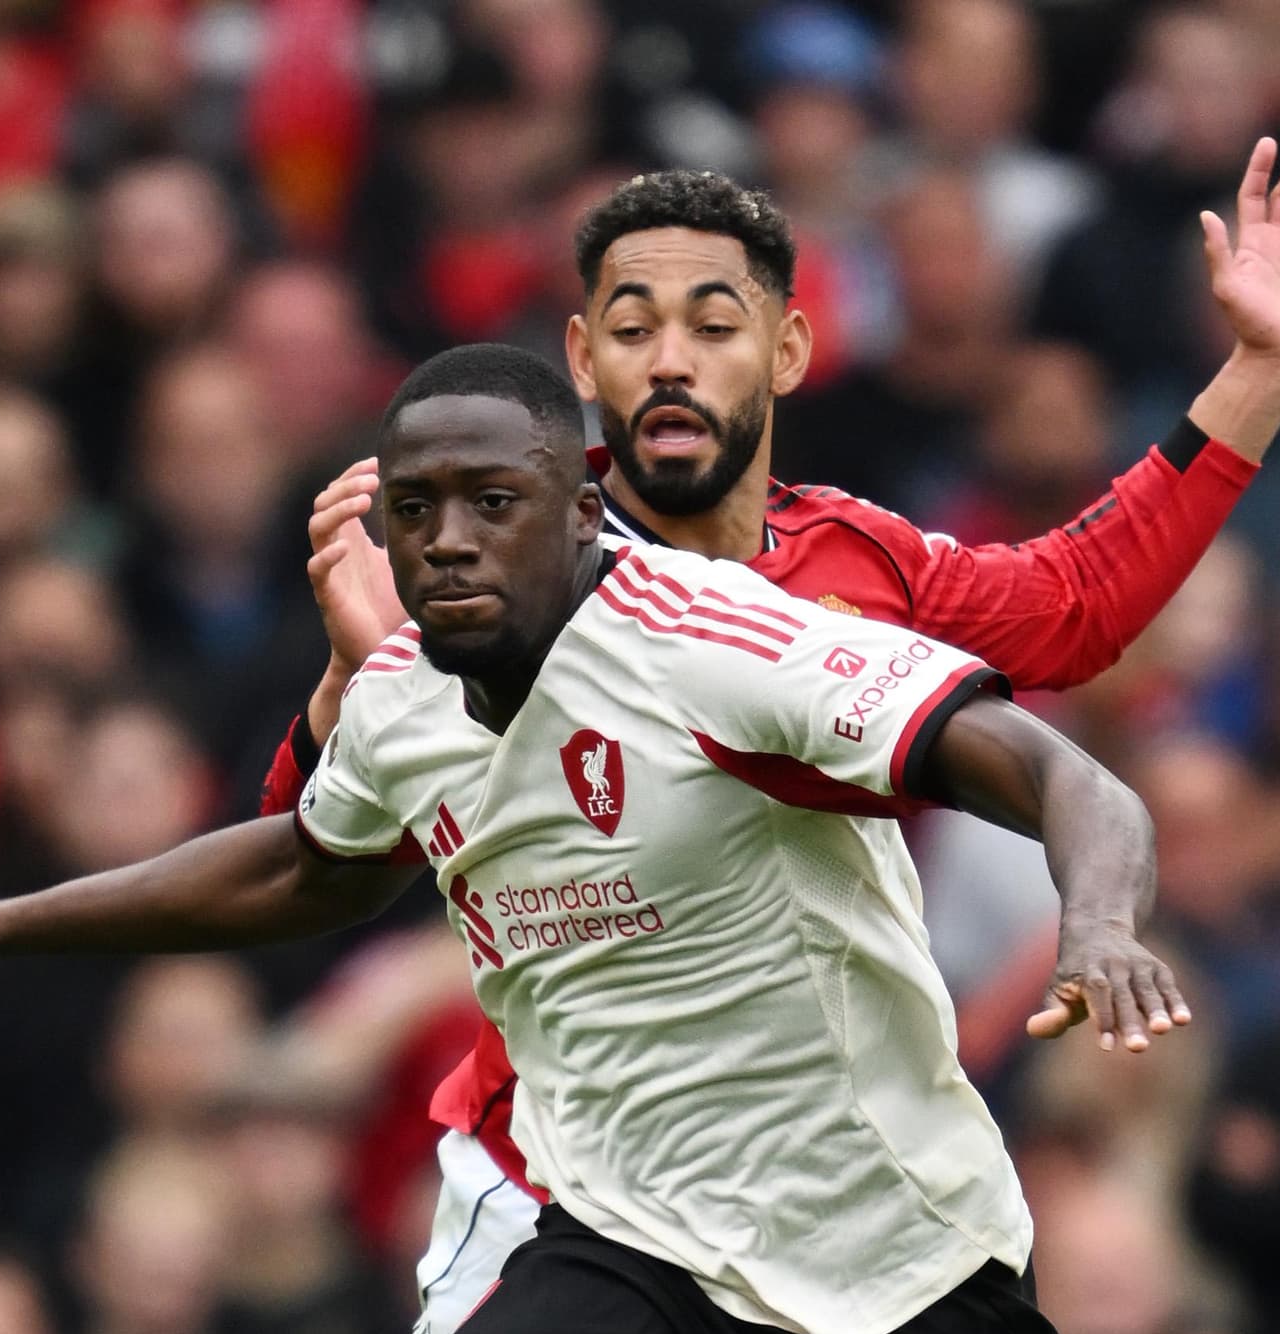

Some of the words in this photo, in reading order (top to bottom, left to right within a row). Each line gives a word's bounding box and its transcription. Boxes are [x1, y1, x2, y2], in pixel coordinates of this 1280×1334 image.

[834, 639, 935, 743] Expedia
[495, 874, 639, 917] standard
[507, 903, 665, 951] chartered
